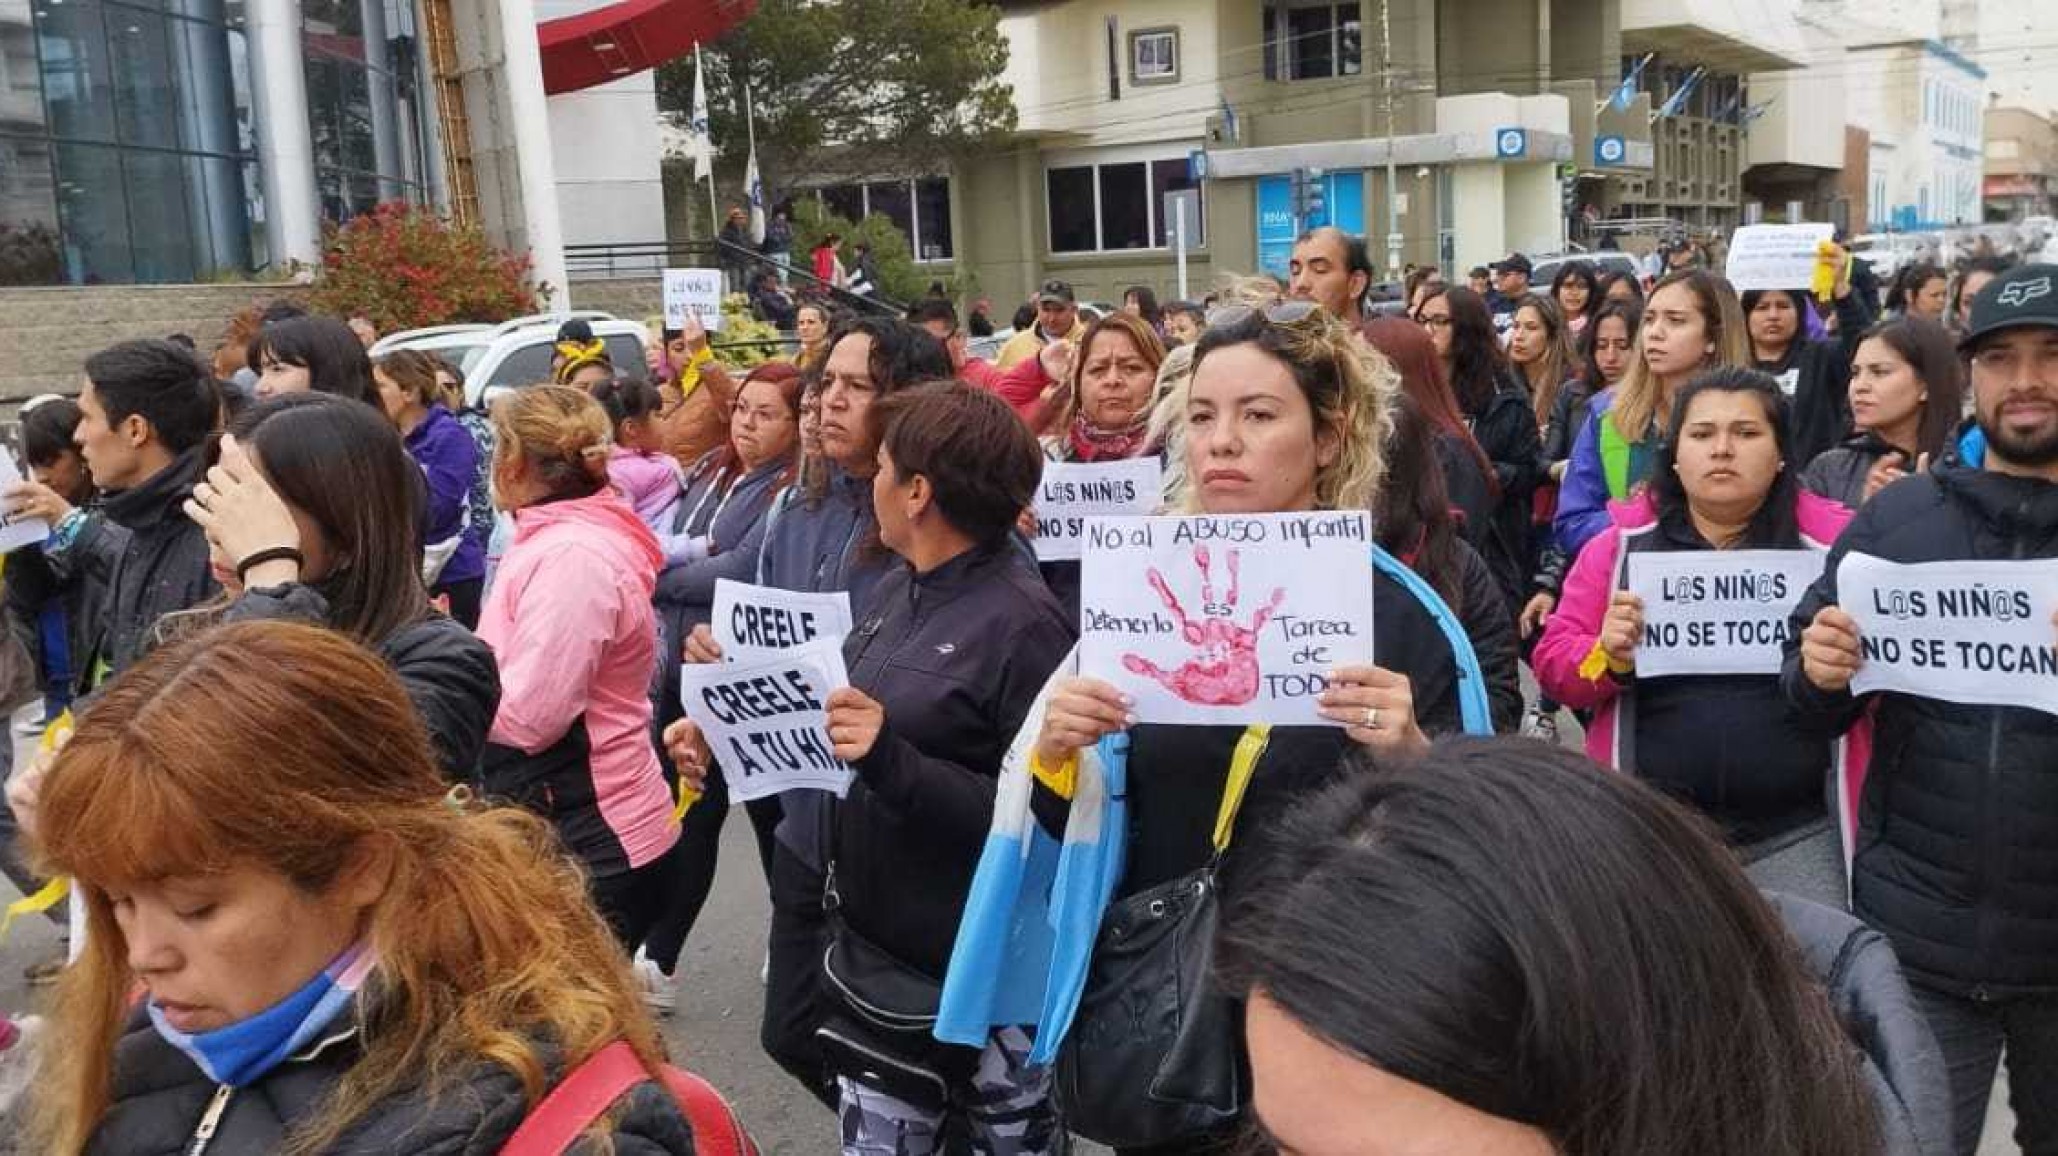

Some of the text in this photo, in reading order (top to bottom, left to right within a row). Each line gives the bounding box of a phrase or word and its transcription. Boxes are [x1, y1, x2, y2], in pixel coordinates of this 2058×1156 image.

[1044, 477, 1136, 505] L@S NIÑ@S
[1038, 518, 1062, 538] NO
[1089, 523, 1122, 550] No
[1131, 523, 1152, 548] al
[1173, 517, 1266, 545] ABUSO
[1662, 569, 1787, 604] L@S NIÑ@S
[1203, 601, 1233, 616] es
[1873, 583, 2032, 621] L@S NIÑ@S
[732, 602, 817, 648] CREELE
[1085, 607, 1174, 634] Detenerlo
[1273, 615, 1356, 642] Tarea
[1646, 619, 1790, 648] NO SE TOCA
[1292, 645, 1332, 665] de
[1860, 635, 2058, 677] NO SE TOCAN
[701, 669, 822, 725] CREELE
[1263, 672, 1331, 699] TOD
[729, 736, 764, 777] A
[748, 730, 801, 771] TU
